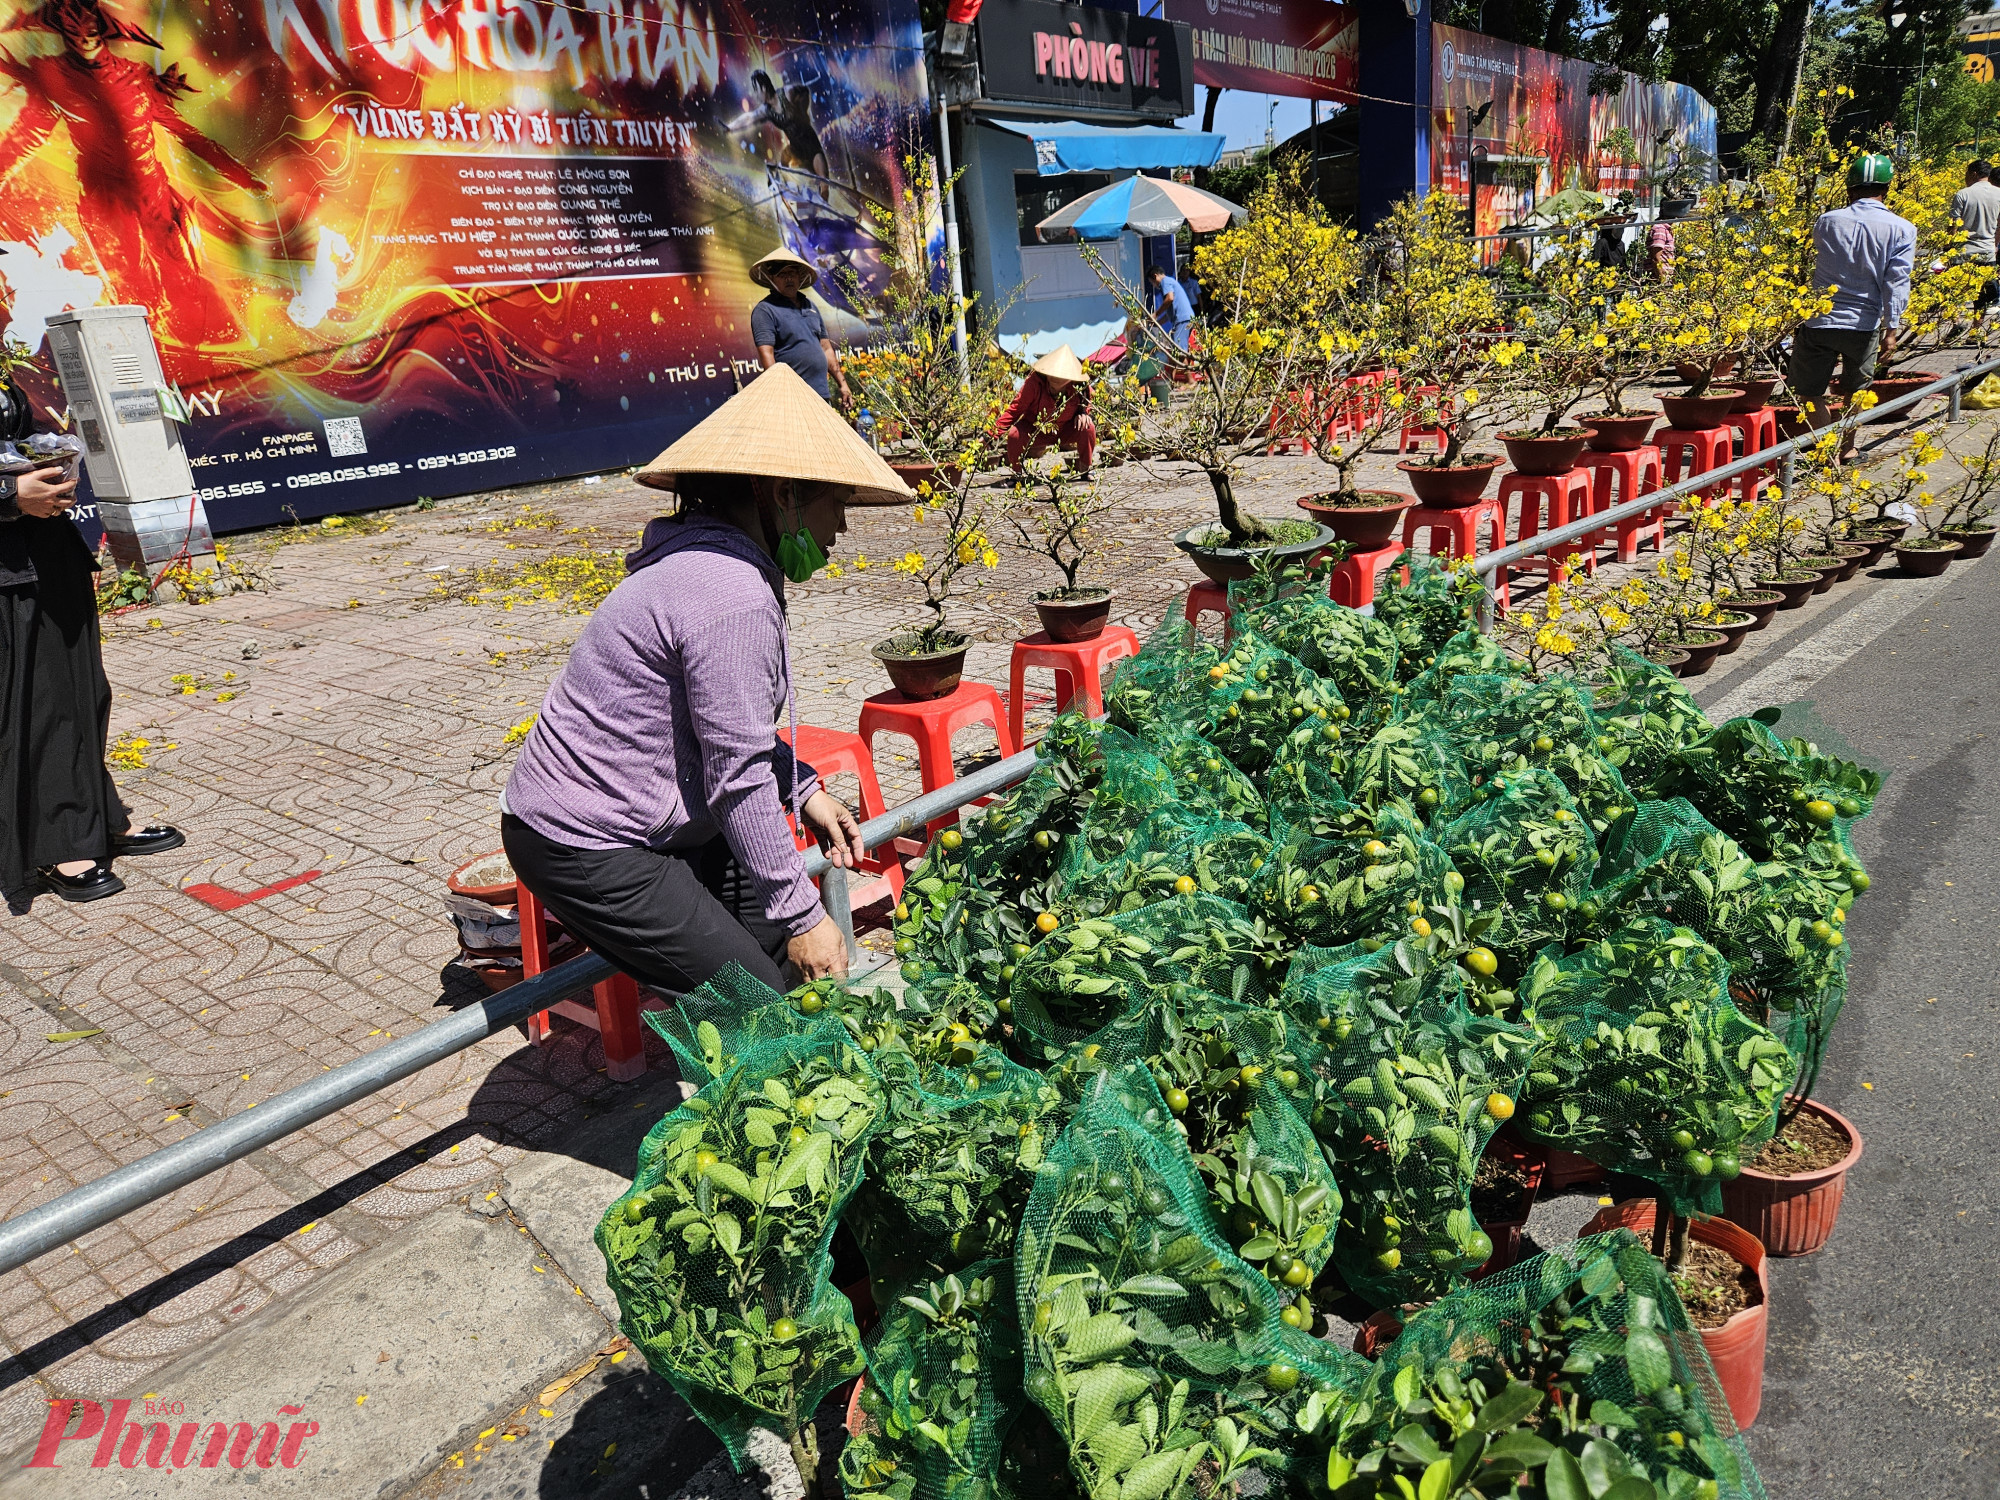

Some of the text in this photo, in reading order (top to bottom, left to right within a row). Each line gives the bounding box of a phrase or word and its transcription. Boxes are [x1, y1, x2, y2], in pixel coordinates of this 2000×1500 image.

[1033, 22, 1124, 85] PHÒNG
[1127, 36, 1160, 89] VÉ
[1202, 27, 1226, 63] NĂM
[1228, 31, 1246, 66] MỚI
[1249, 38, 1273, 69] XUÂN
[1275, 39, 1295, 74] BÍNH
[1314, 51, 1336, 80] 2026
[1457, 52, 1475, 68] TRUNG
[1476, 55, 1488, 71] TÂM
[1502, 62, 1519, 78] THUẬT
[430, 101, 482, 142] ĐẤT
[493, 106, 522, 144] KỲ
[531, 108, 554, 145] BÍ
[556, 108, 608, 146] TIỀN
[476, 170, 496, 181] ĐẠO
[498, 169, 523, 181] NGHỆ
[557, 167, 573, 180] LÊ
[461, 185, 484, 197] KỊCH
[514, 186, 533, 197] ĐẠO
[558, 183, 588, 195] CÔNG
[516, 202, 535, 212] ĐẠO
[560, 199, 597, 211] QUANG
[451, 215, 474, 227] BIÊN
[475, 217, 495, 228] ĐẠO
[504, 215, 525, 227] BIÊN
[526, 215, 544, 227] TẬP
[586, 213, 616, 227] MẠNH
[371, 235, 406, 245] TRANG
[439, 231, 466, 243] THU
[469, 229, 497, 245] HIỆP
[557, 227, 588, 240] QUỐC
[696, 226, 715, 236] ANH
[510, 247, 535, 258] THAM
[536, 247, 551, 257] GIA
[571, 244, 588, 255] CÁC
[590, 244, 613, 256] NGHỆ
[453, 265, 486, 275] TRUNG
[487, 263, 507, 274] TÂM
[508, 261, 533, 274] NGHỆ
[534, 260, 564, 273] THUẬT
[641, 257, 660, 267] MINH
[665, 361, 699, 383] THỨ
[704, 364, 717, 378] 6
[261, 431, 314, 446] FANPAGE
[188, 453, 219, 468] XIẾC
[221, 453, 243, 466] TP.
[245, 447, 263, 461] HỒ
[288, 443, 318, 458] MINH
[286, 462, 401, 489] 0928.055.992
[417, 446, 517, 471] 0934.303.302
